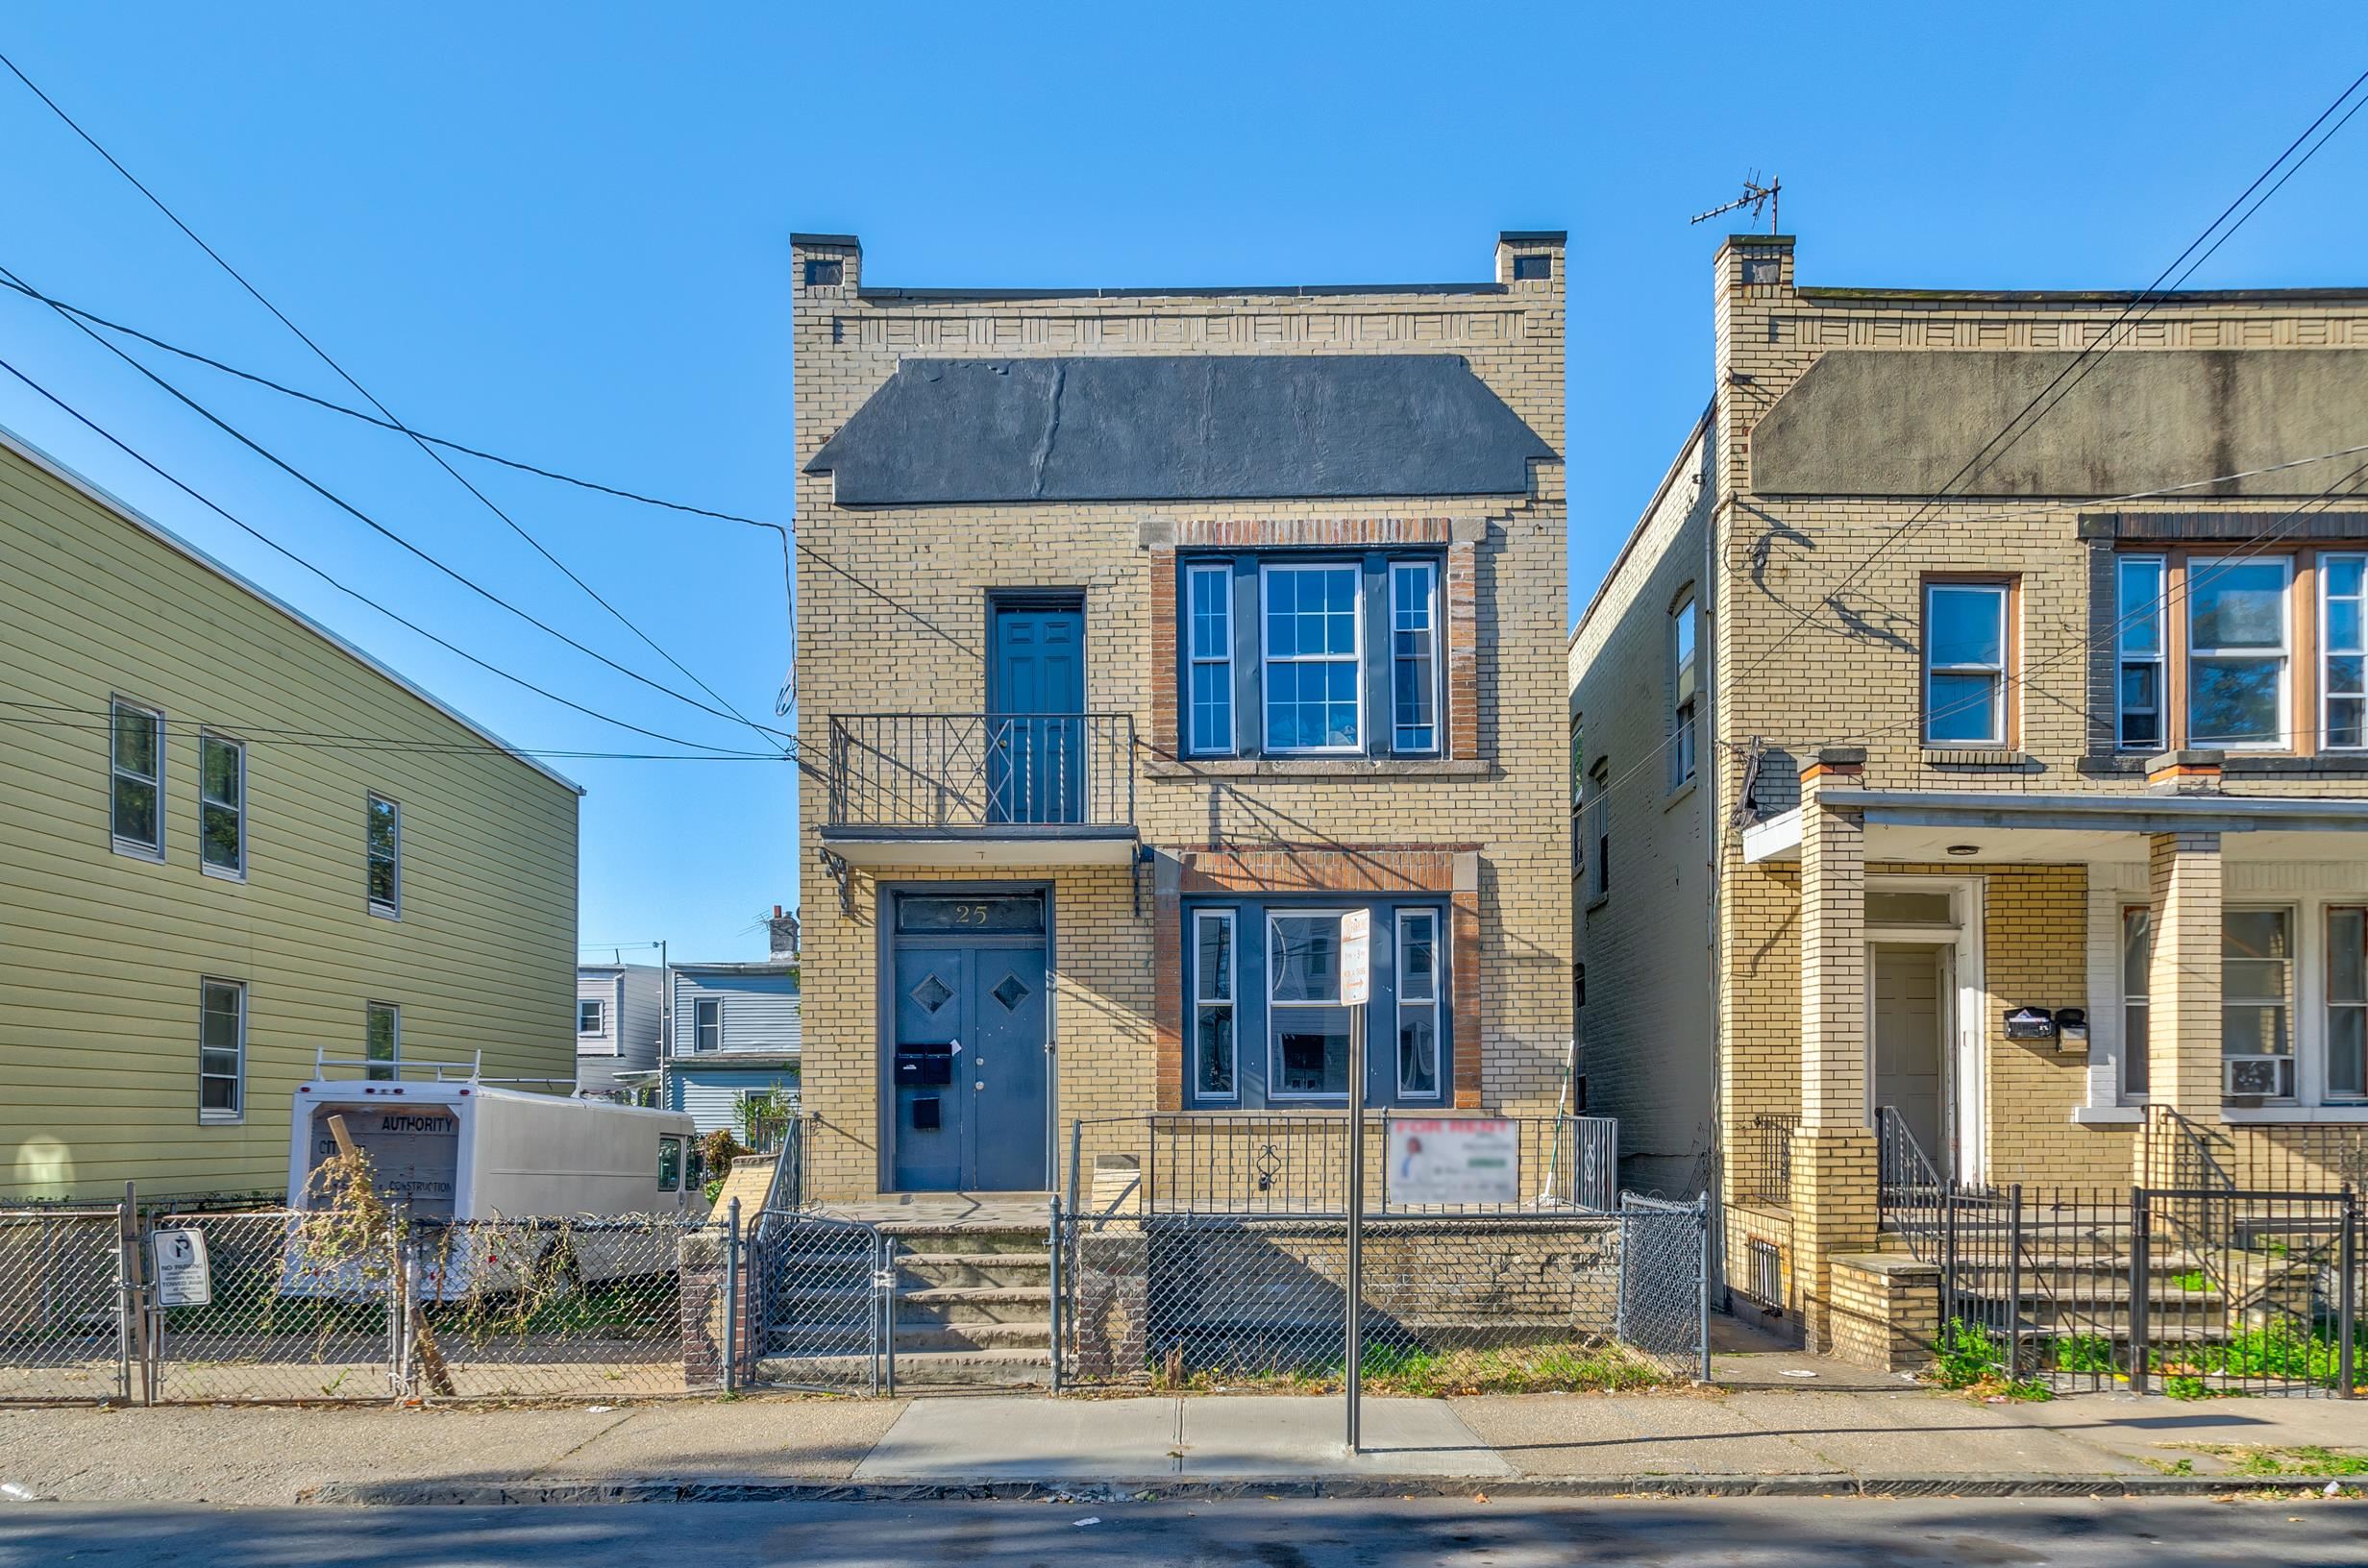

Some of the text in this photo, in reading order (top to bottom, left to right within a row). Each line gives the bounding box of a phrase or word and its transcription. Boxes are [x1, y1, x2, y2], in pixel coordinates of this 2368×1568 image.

[955, 905, 988, 925] 25
[382, 1115, 453, 1132] AUTHORITY
[388, 1180, 452, 1191] CONSTRUCTION
